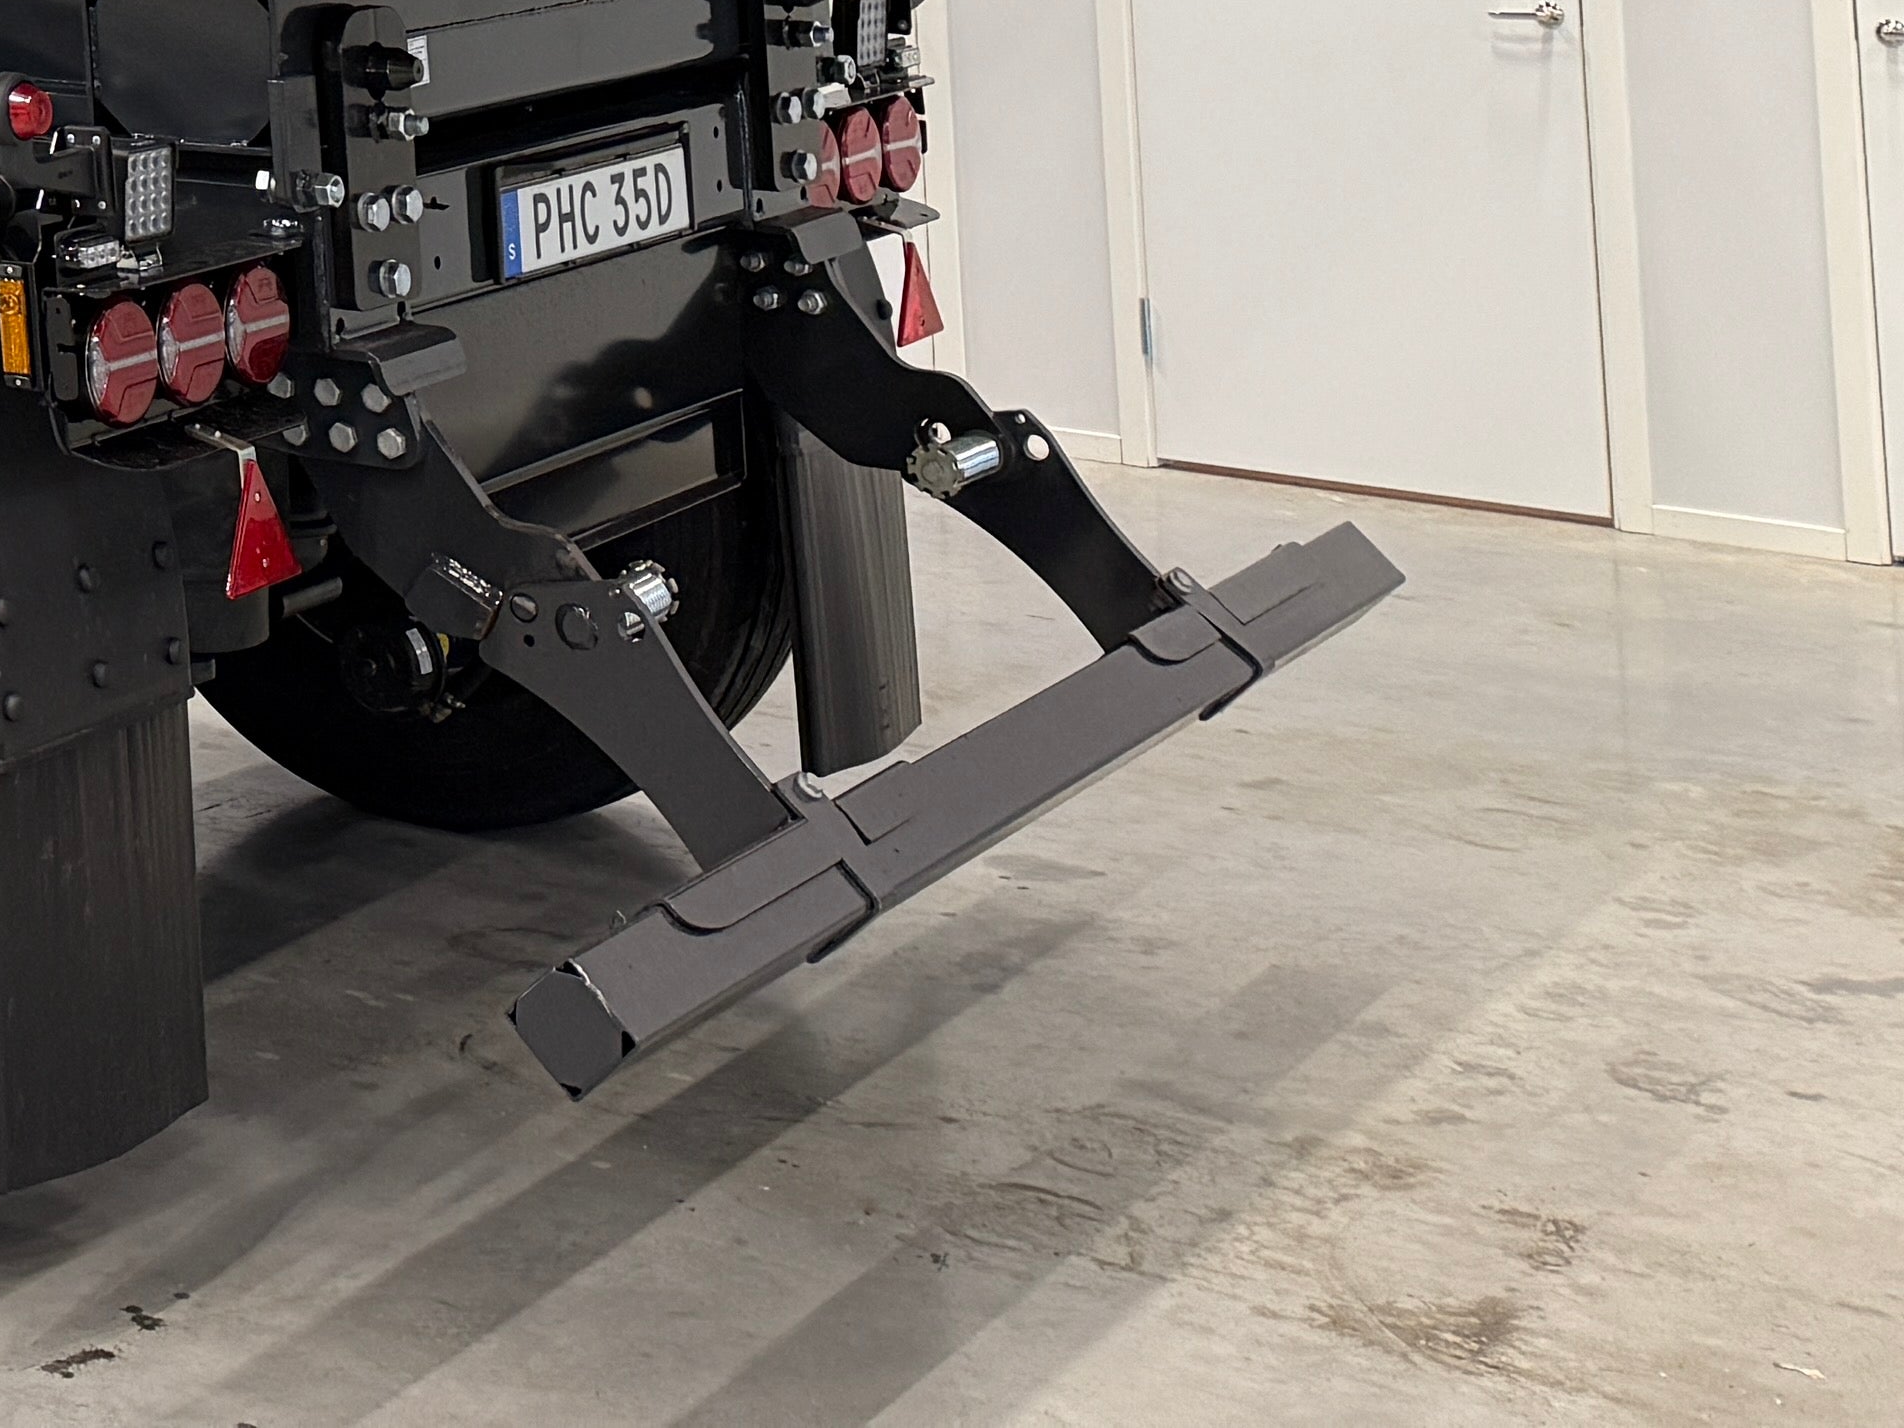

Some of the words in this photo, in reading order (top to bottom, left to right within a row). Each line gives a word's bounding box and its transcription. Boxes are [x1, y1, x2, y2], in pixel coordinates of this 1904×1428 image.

[532, 180, 601, 260] PHC
[610, 162, 673, 238] 35D
[508, 243, 517, 260] S
